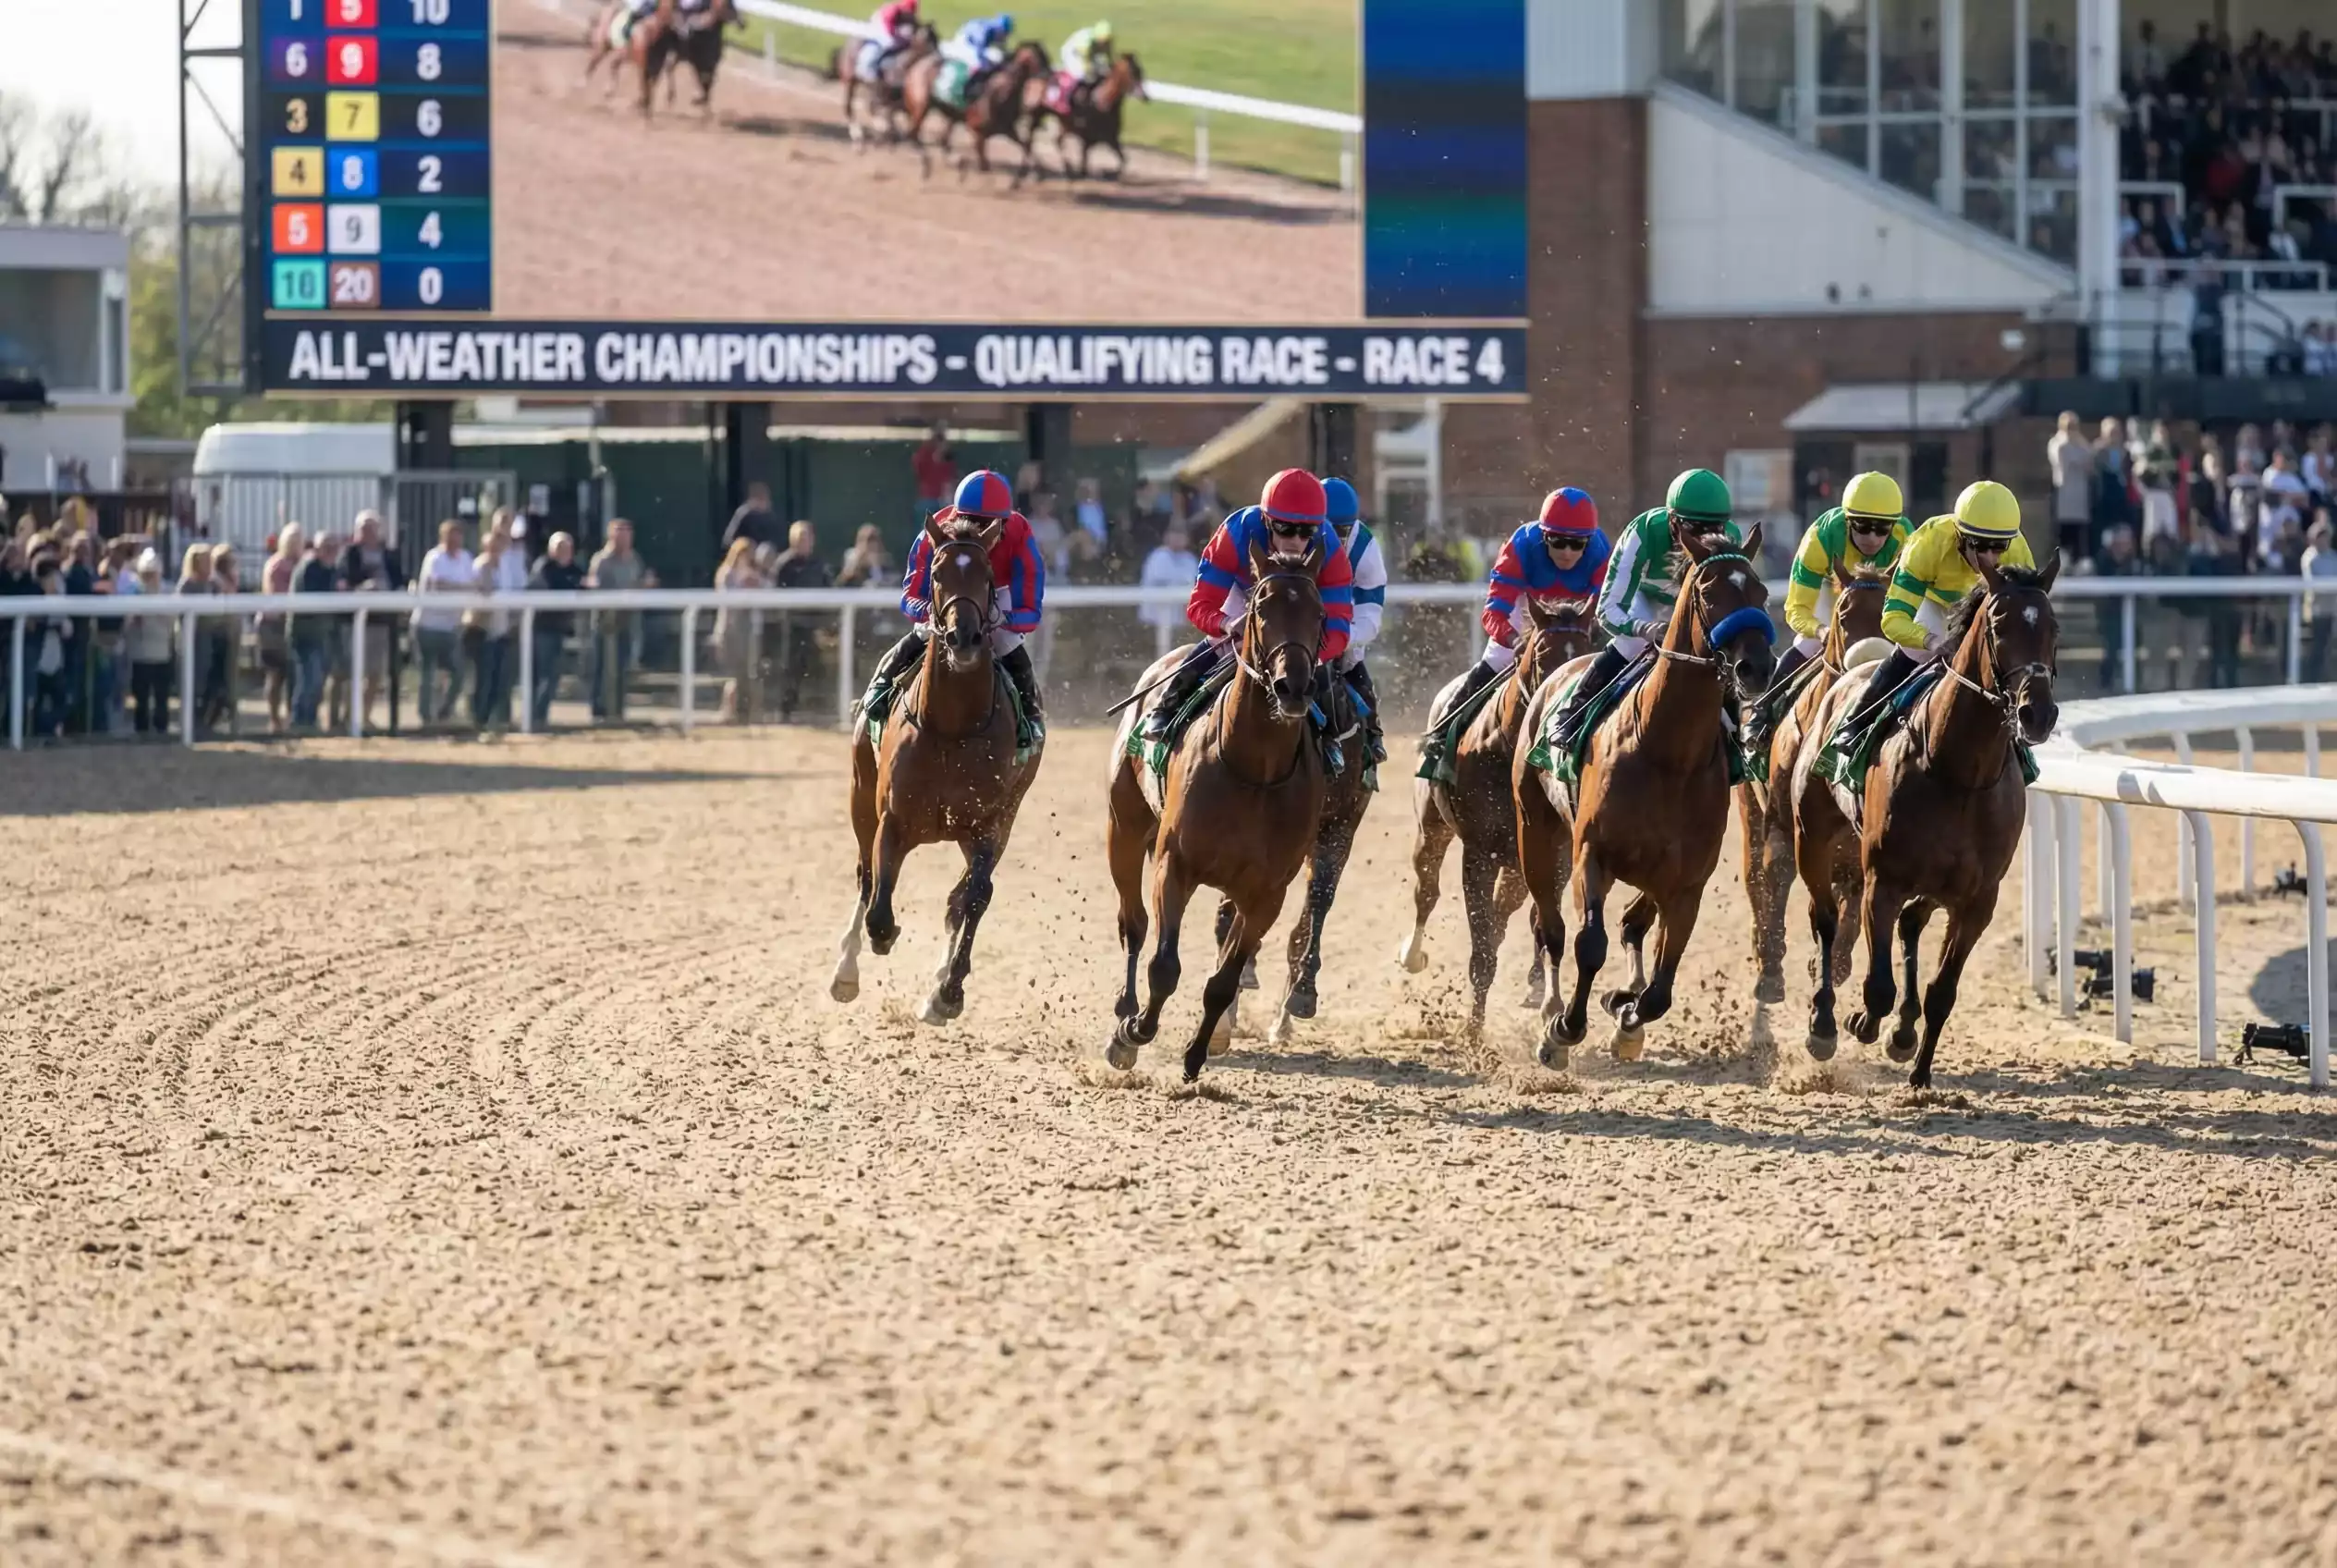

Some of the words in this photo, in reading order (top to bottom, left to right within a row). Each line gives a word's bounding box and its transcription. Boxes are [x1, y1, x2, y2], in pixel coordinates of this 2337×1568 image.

[410, 0, 449, 24] 10
[286, 42, 307, 77] 6
[340, 43, 363, 78] 9
[417, 43, 442, 80] 8
[286, 98, 308, 133] 3
[345, 102, 362, 130] 7
[417, 100, 442, 137] 6
[288, 158, 306, 184] 4
[418, 155, 442, 192] 2
[288, 212, 309, 246] 5
[346, 216, 362, 243] 9
[419, 212, 442, 248] 4
[334, 267, 373, 302] 20
[419, 267, 442, 304] 0
[288, 330, 586, 382] ALL-WEATHER
[594, 332, 938, 385] CHAMPIONSHIPS
[945, 355, 967, 370] -
[974, 335, 1214, 387] QUALIFYING
[1220, 336, 1329, 386] RACE
[1335, 356, 1356, 371] -
[1364, 337, 1471, 386] RACE
[1474, 337, 1505, 385] 4
